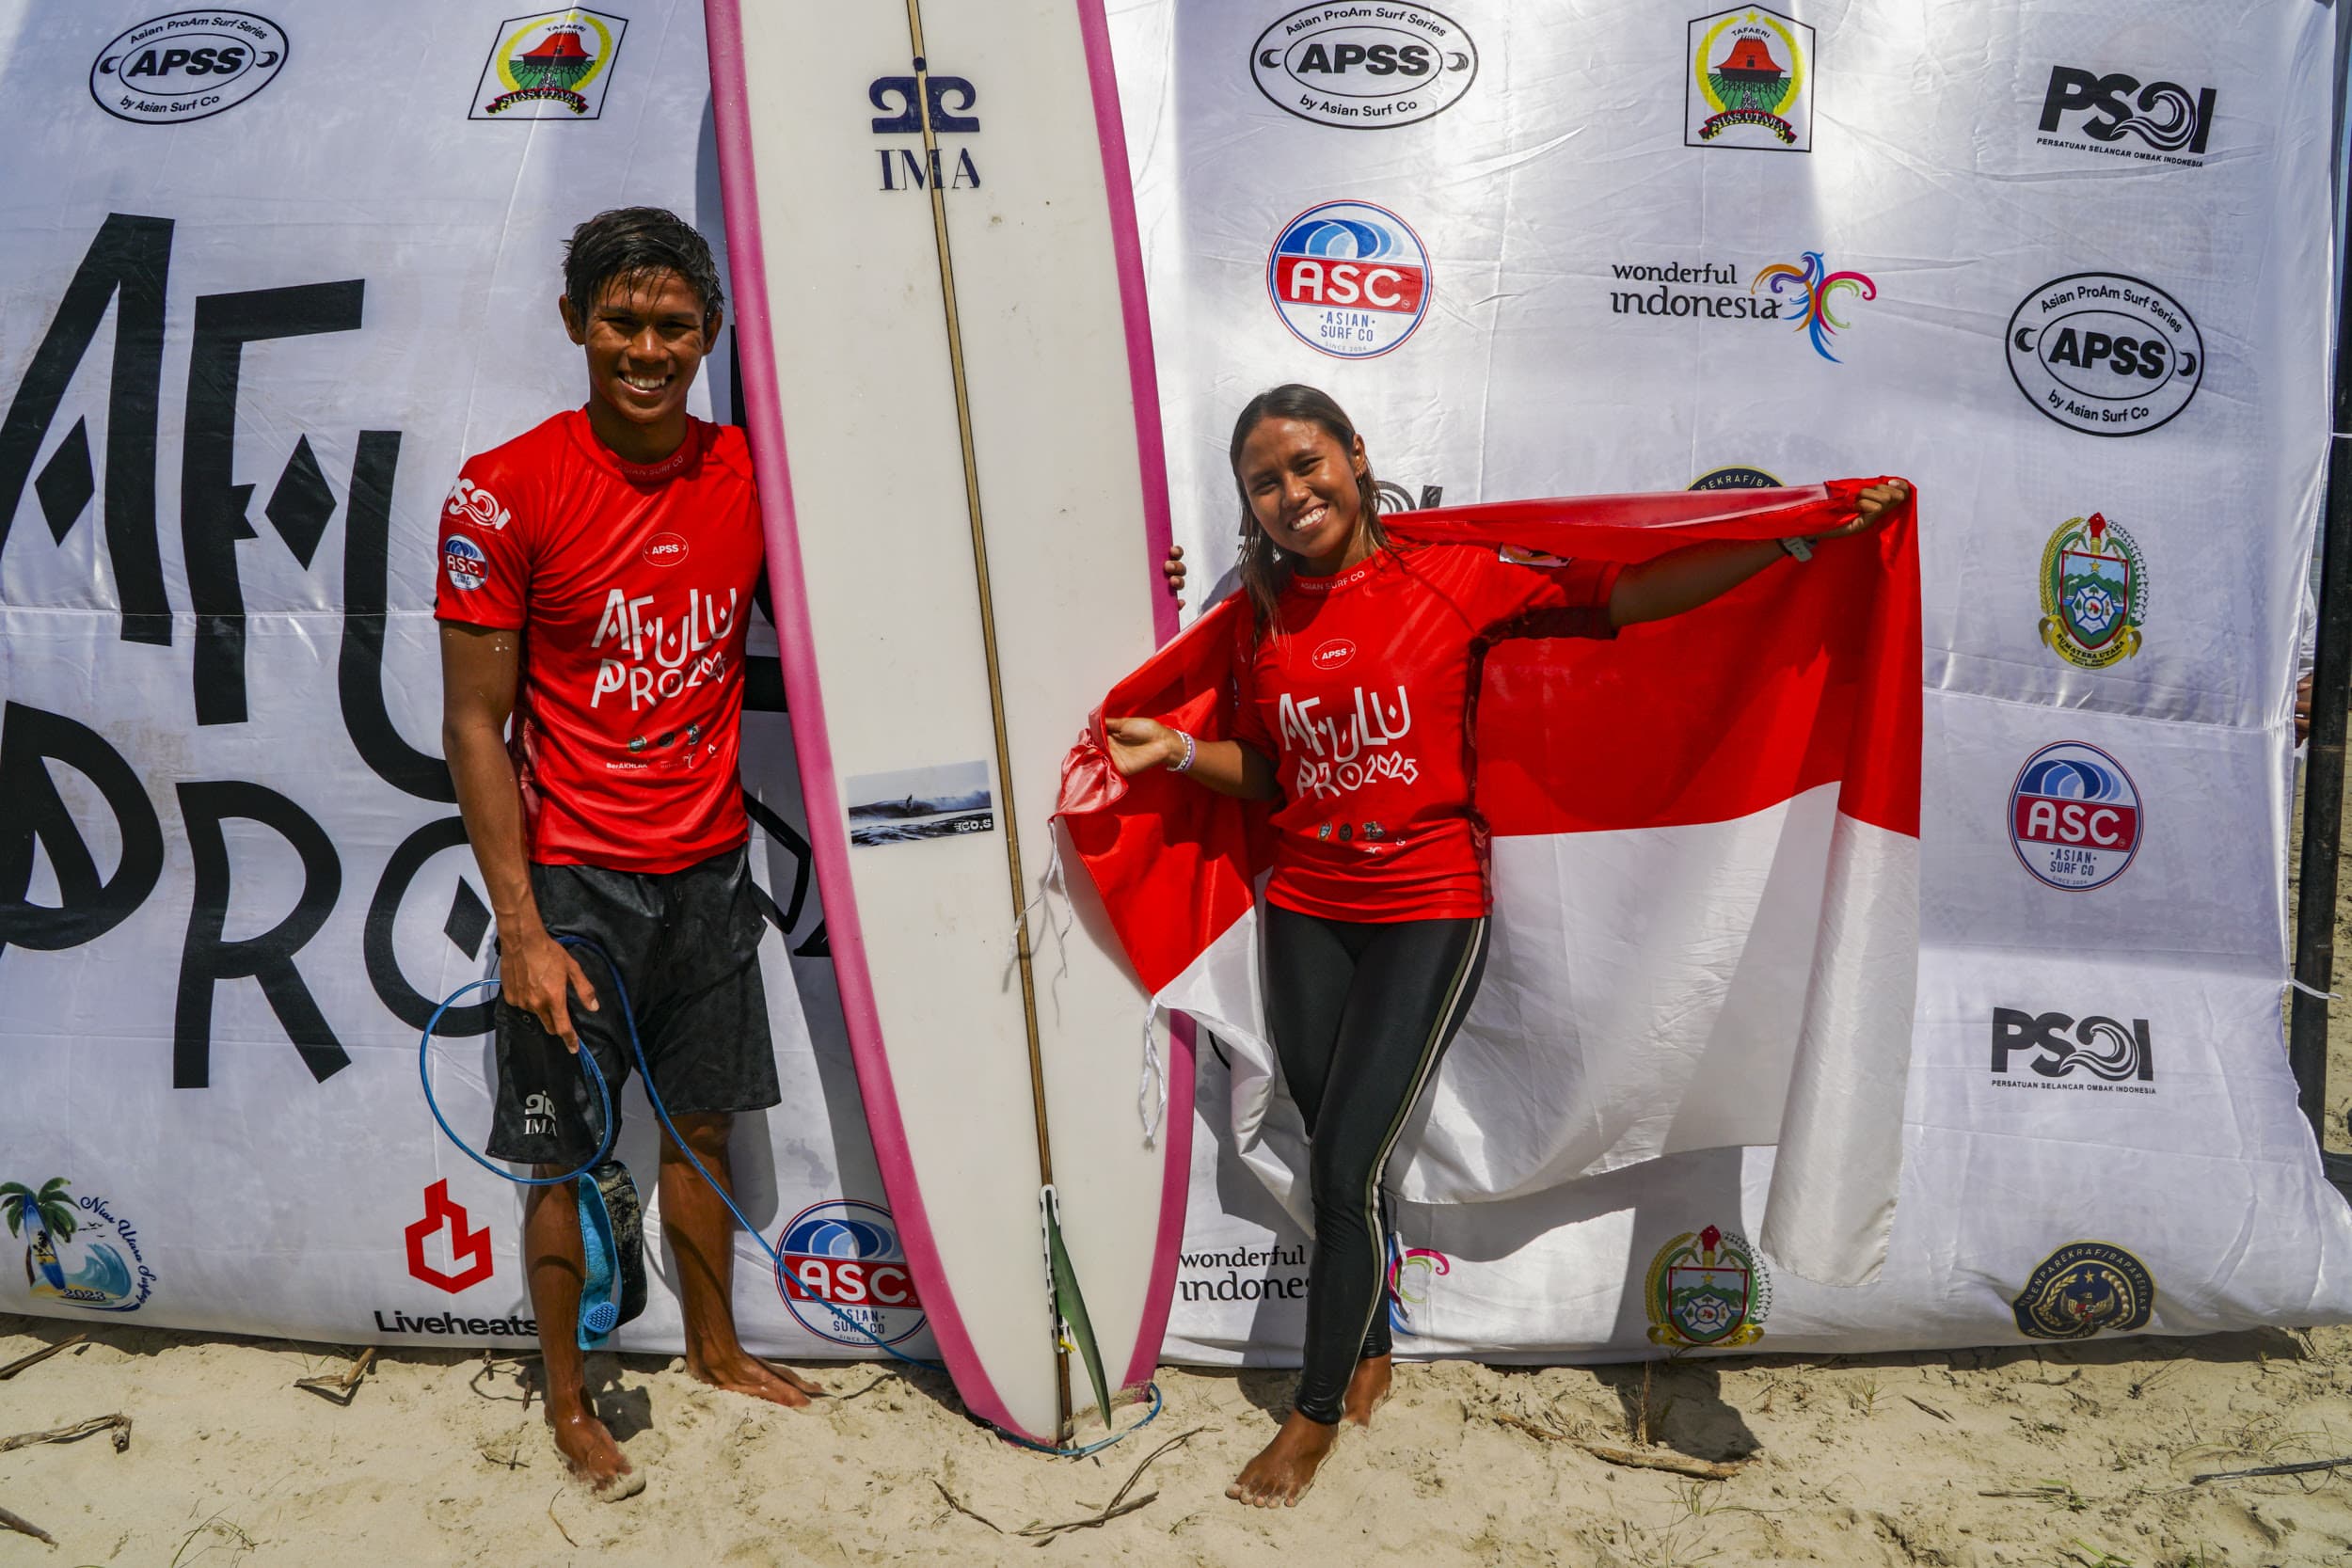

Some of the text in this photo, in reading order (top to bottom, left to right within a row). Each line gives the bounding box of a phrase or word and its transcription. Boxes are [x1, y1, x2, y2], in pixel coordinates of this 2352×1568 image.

[130, 16, 267, 44] Asian ProAm Surf Series
[1285, 7, 1446, 38] Asian ProAm Surf Series
[126, 47, 246, 77] APSS
[1296, 43, 1430, 77] APSS
[120, 95, 220, 113] by Asian Surf Co
[1299, 94, 1418, 118] by Asian Surf Co
[1712, 113, 1785, 130] NIAS UTARA
[2036, 137, 2203, 167] PERSATUAN SELANCAR OMBAK INDONESIA
[875, 148, 981, 191] IMA
[1291, 261, 1402, 308] ASC
[1612, 261, 1738, 285] wonderful
[1610, 285, 1783, 320] indonesia
[2041, 284, 2183, 334] Asian ProAm Surf Series
[1326, 311, 1369, 327] ASIAN
[1321, 325, 1374, 342] SURF CO
[2047, 327, 2167, 380] APSS
[2047, 388, 2150, 422] by Asian Surf Co
[652, 544, 678, 555] APSS
[447, 555, 479, 575] ASC
[1326, 578, 1348, 590] SURF
[1350, 570, 1365, 582] CO
[591, 588, 737, 668] AFULU
[1322, 648, 1346, 660] APSS
[1279, 685, 1411, 763] AFULU
[2027, 800, 2121, 846] ASC
[2050, 861, 2095, 876] SURF CO
[2055, 848, 2092, 864] ASIAN
[1992, 1080, 2156, 1095] PERSATUAN SELANCAR OMBAK INDONESIA
[523, 1118, 557, 1136] IMA
[80, 1196, 116, 1224] Nias
[1181, 1245, 1305, 1268] wonderful
[800, 1259, 907, 1304] ASC
[1180, 1271, 1310, 1301] indone
[373, 1310, 538, 1337] Liveheats
[870, 1323, 884, 1333] CO
